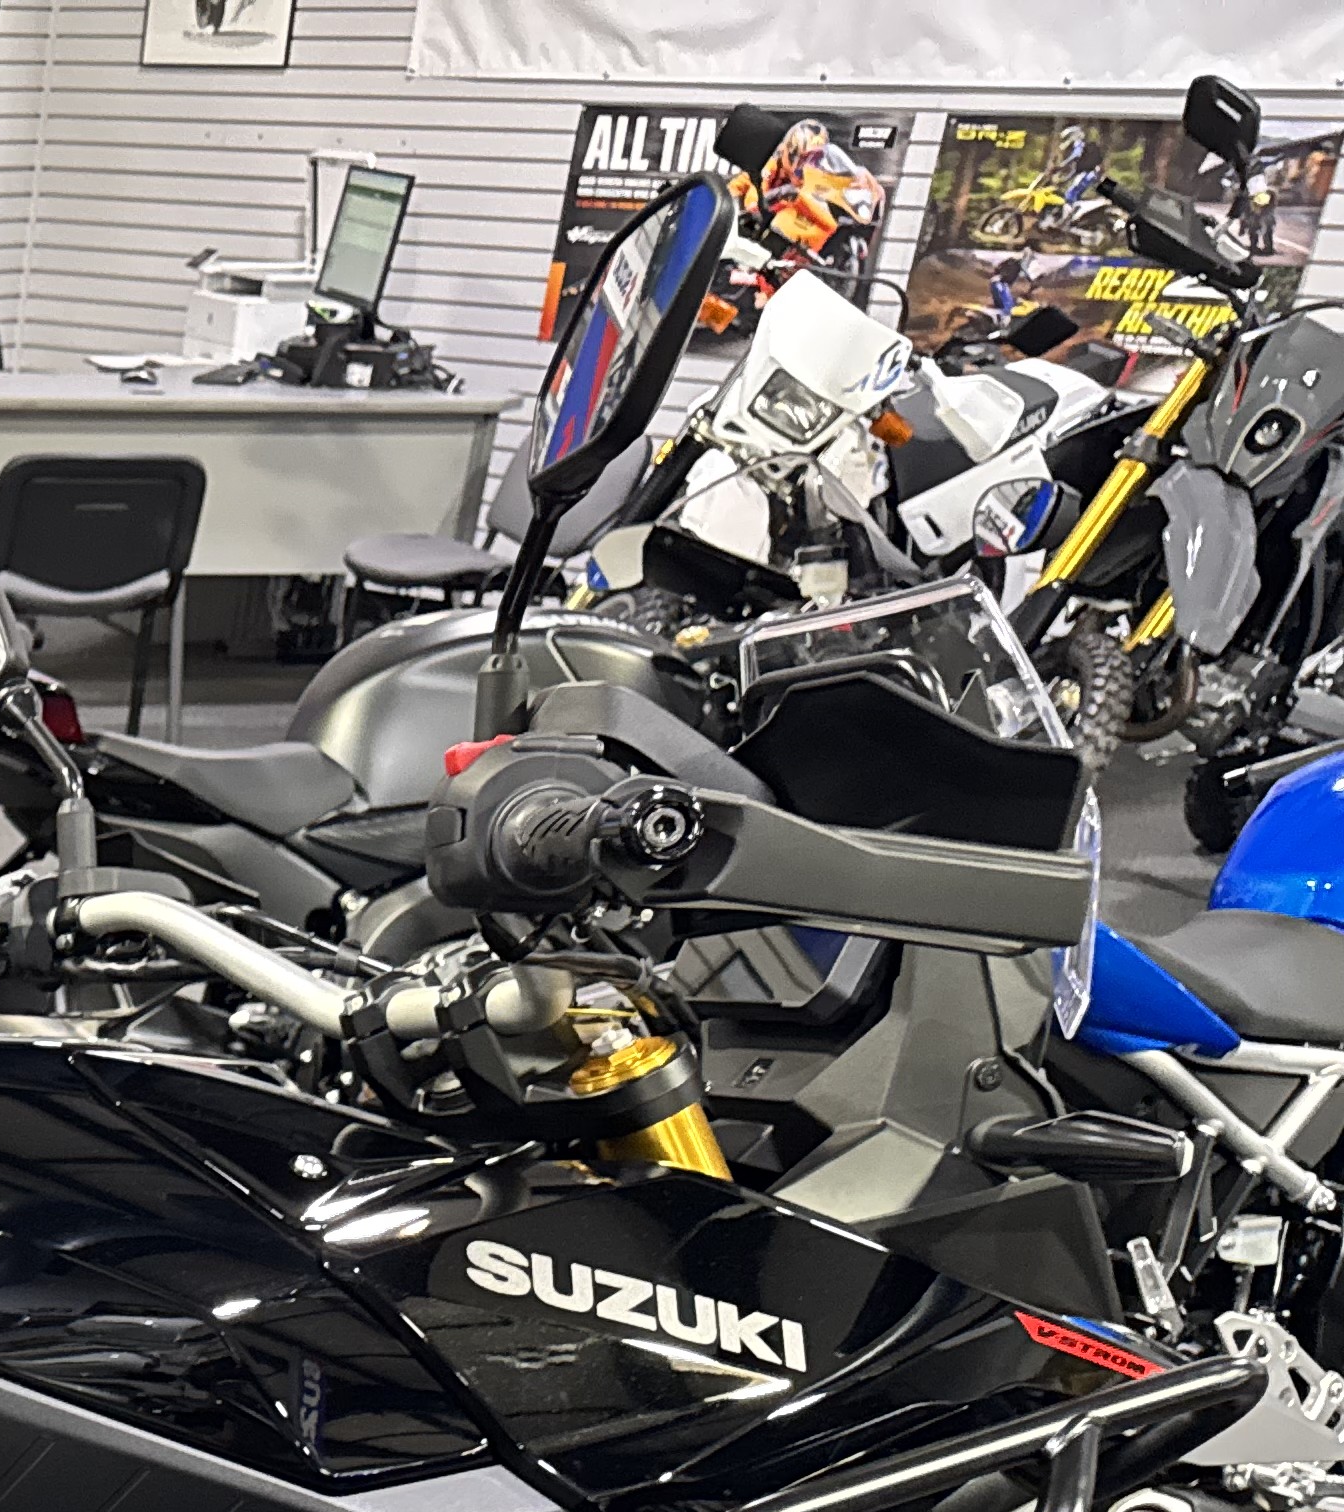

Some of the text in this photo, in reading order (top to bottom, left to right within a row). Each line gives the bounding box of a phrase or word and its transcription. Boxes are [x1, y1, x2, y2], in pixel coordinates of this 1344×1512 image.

[581, 114, 742, 176] ALL TIM
[1085, 266, 1176, 301] READY
[466, 1240, 807, 1373] SUZUKI
[1037, 1326, 1146, 1374] V-STROM
